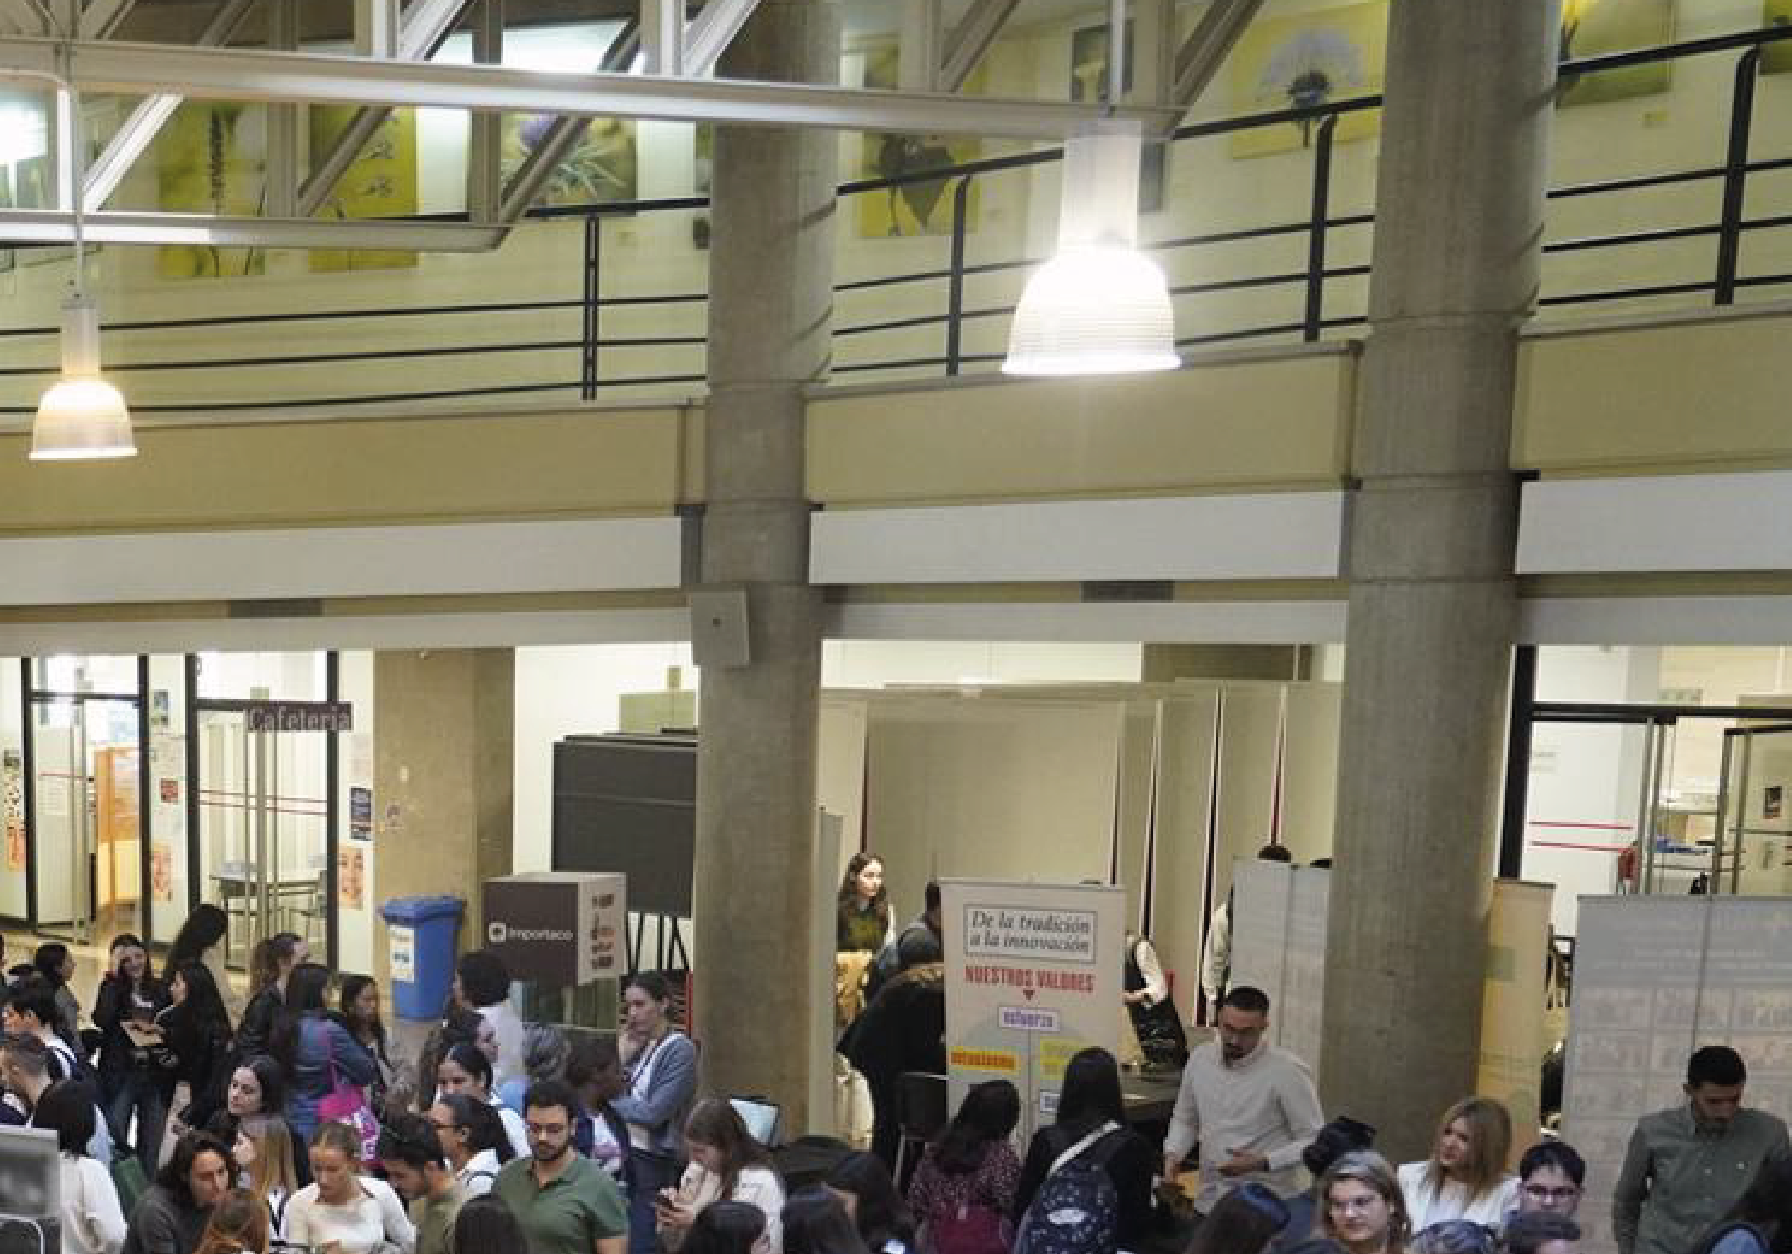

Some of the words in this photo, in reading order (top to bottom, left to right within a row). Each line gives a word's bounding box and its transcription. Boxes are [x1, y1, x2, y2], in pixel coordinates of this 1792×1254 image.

[250, 705, 350, 731] Cafeteria
[972, 910, 994, 929] De
[998, 910, 1014, 929] la
[1020, 912, 1090, 934] tradición
[984, 930, 1000, 948] la
[965, 965, 1034, 987] NUESTROS
[1037, 969, 1094, 993] VALORES
